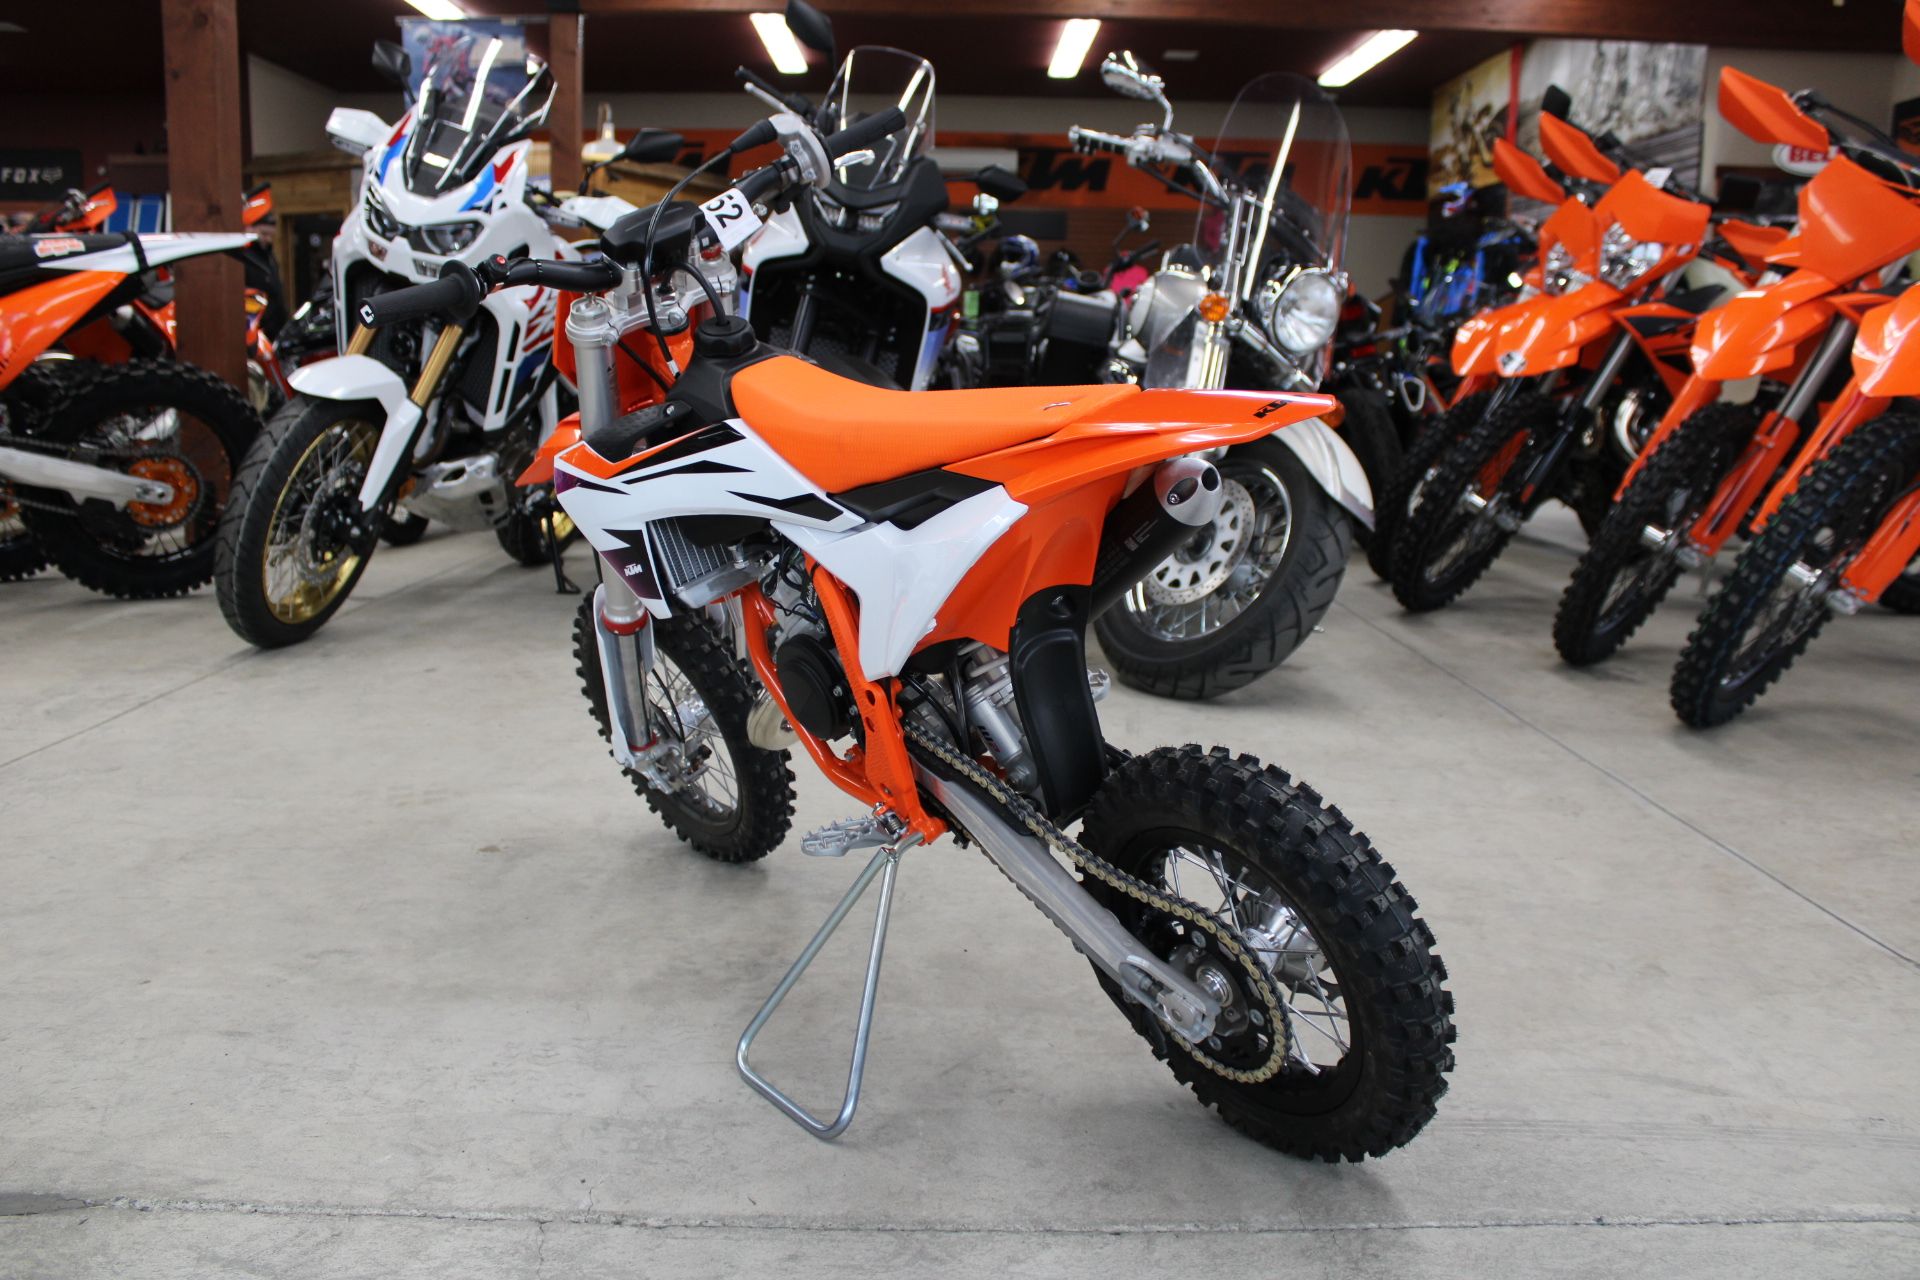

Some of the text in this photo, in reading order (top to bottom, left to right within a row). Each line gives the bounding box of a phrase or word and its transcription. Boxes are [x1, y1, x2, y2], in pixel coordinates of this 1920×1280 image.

[1, 167, 40, 184] FOX
[1018, 147, 1111, 192] TM
[1355, 157, 1429, 199] KT
[624, 563, 643, 577] KTM
